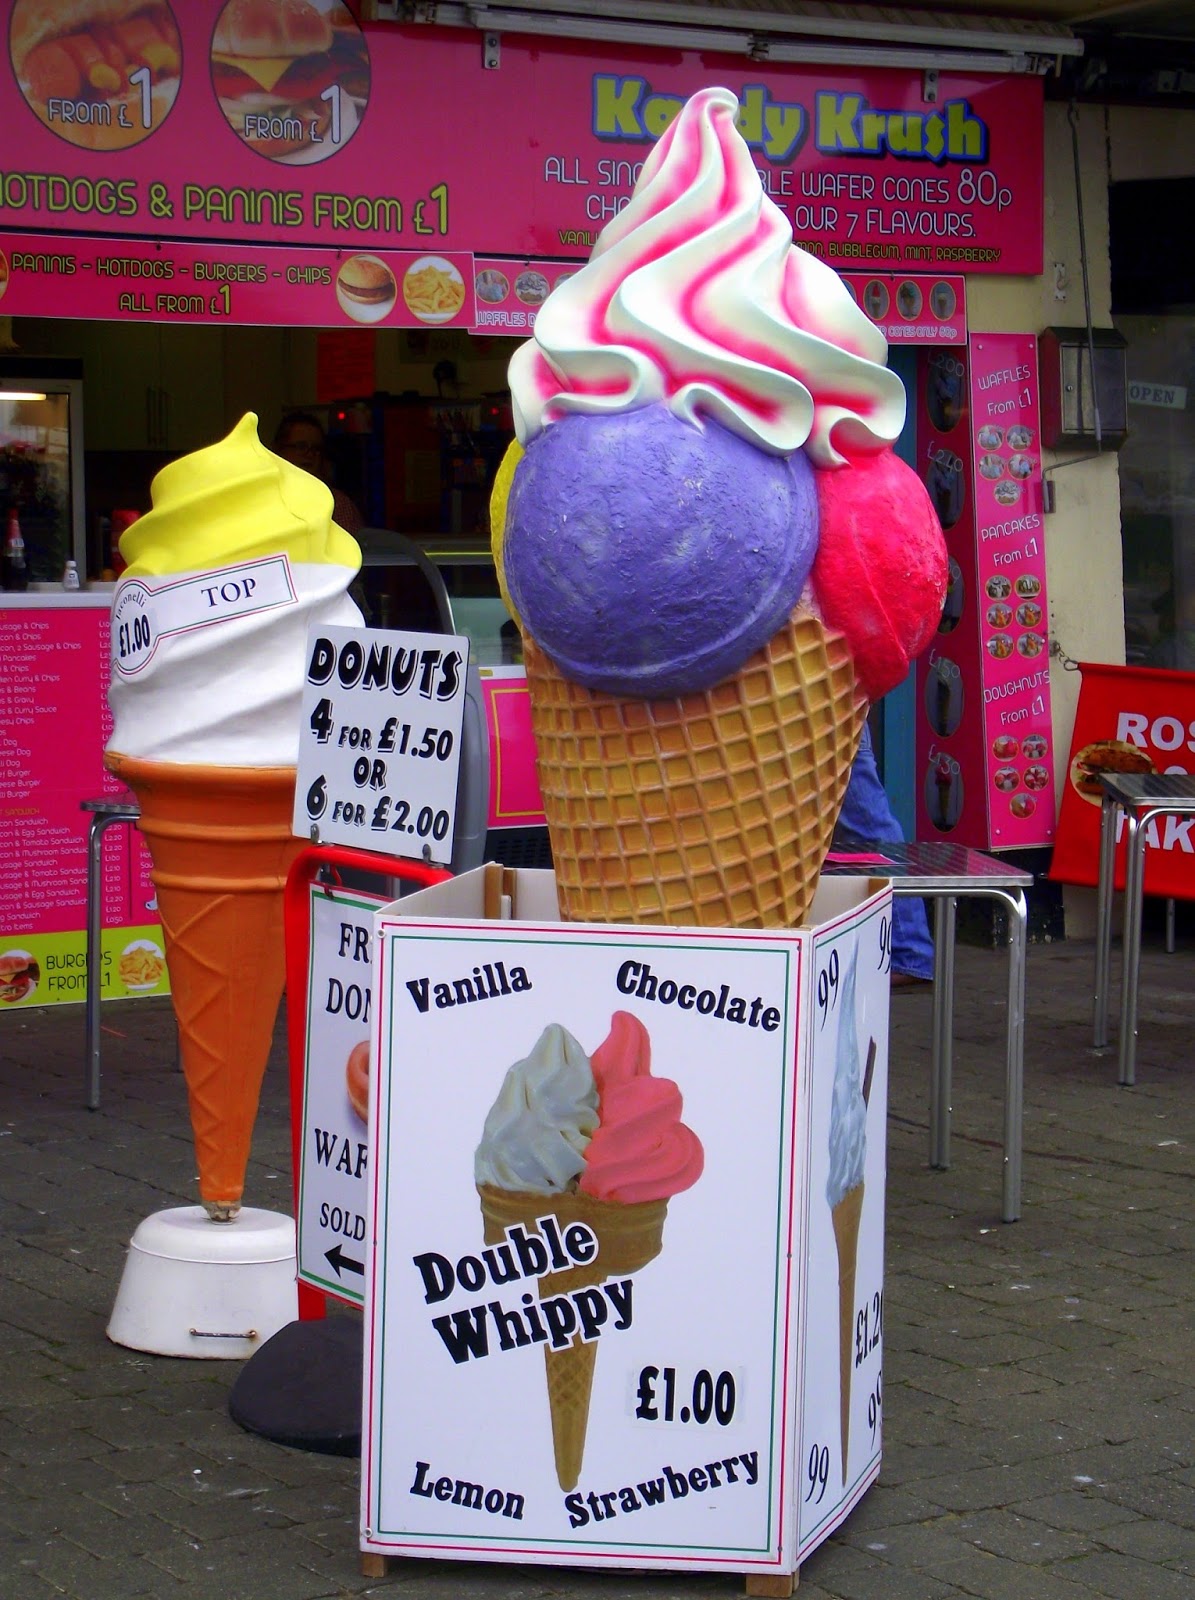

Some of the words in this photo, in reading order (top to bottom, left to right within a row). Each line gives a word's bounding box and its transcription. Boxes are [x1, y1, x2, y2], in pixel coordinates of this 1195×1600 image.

[48, 99, 111, 126] FROM
[118, 67, 152, 129] £1
[244, 115, 303, 141] FROM
[308, 84, 342, 144] £1
[592, 73, 807, 163] Kady
[815, 90, 990, 163] Krush
[544, 157, 589, 185] ALL
[802, 171, 875, 200] WAFER
[882, 176, 950, 204] CONES
[957, 168, 1012, 211] 80p
[0, 172, 138, 215] OTDOGS
[150, 184, 174, 218] &
[185, 187, 303, 226] PANINIS
[313, 195, 402, 232] FROM
[413, 183, 450, 235] £1
[795, 205, 838, 231] OUR
[846, 213, 859, 238] 7
[866, 209, 977, 237] FLAVOURS.
[12, 253, 76, 274] PANINIS
[97, 258, 175, 278] HOTDOGS
[194, 263, 267, 283] BURGERS
[287, 267, 332, 285] CHIPS
[936, 247, 1001, 263] RASPBERRY
[119, 293, 151, 312] ALL
[157, 295, 204, 313] FROM
[210, 283, 231, 314] £1
[477, 311, 526, 327] WAFFLES
[888, 325, 917, 338] CONES
[917, 326, 938, 338] ONLY
[977, 364, 1031, 391] WAFFLES
[987, 399, 1016, 417] From
[1018, 387, 1032, 409] £1
[1129, 385, 1175, 404] OPEN
[981, 513, 1040, 542] PANCAKES
[993, 549, 1022, 567] From
[1025, 537, 1038, 558] £1
[200, 577, 257, 609] TOP
[23, 642, 54, 651] Sausage
[119, 614, 151, 658] £1.00
[307, 637, 463, 702] DONUTS
[983, 669, 1050, 704] DOUGHNUTS
[1000, 706, 1029, 726] From
[1031, 694, 1045, 716] £1
[309, 697, 334, 745] 4
[338, 725, 373, 752] FOR
[377, 716, 454, 762] £1.50
[353, 756, 388, 791] OR
[15, 818, 49, 827] Sandwich
[306, 774, 328, 821] 6
[332, 800, 366, 827] FOR
[370, 795, 450, 842] £2.00
[22, 829, 35, 838] Egg
[37, 827, 71, 836] Sandwich
[23, 839, 49, 847] Tomato
[51, 837, 84, 845] Sandwich
[22, 849, 59, 857] Mushroom
[61, 847, 89, 855] Sandwic
[24, 859, 58, 868] Sandwich
[32, 869, 59, 877] Tomato
[60, 867, 89, 875] Sandwic
[32, 880, 68, 888] Mushroom
[70, 877, 88, 885] Sand
[23, 901, 54, 910] Sausage
[31, 890, 45, 899] Egg
[46, 889, 80, 897] Sandwich
[7, 912, 41, 921] Sandwich
[46, 950, 112, 970] BURGS
[405, 961, 532, 1013] Vanilla
[616, 959, 782, 1033] Chocolate
[818, 949, 840, 1032] 99
[314, 1127, 368, 1179] WAF
[319, 1202, 366, 1242] SOLD
[412, 1217, 598, 1305] Double
[431, 1279, 634, 1364] Whippy
[636, 1365, 736, 1427] £1.00
[564, 1450, 759, 1529] Strawberry
[804, 1443, 829, 1504] 99
[409, 1461, 526, 1520] Lemon
